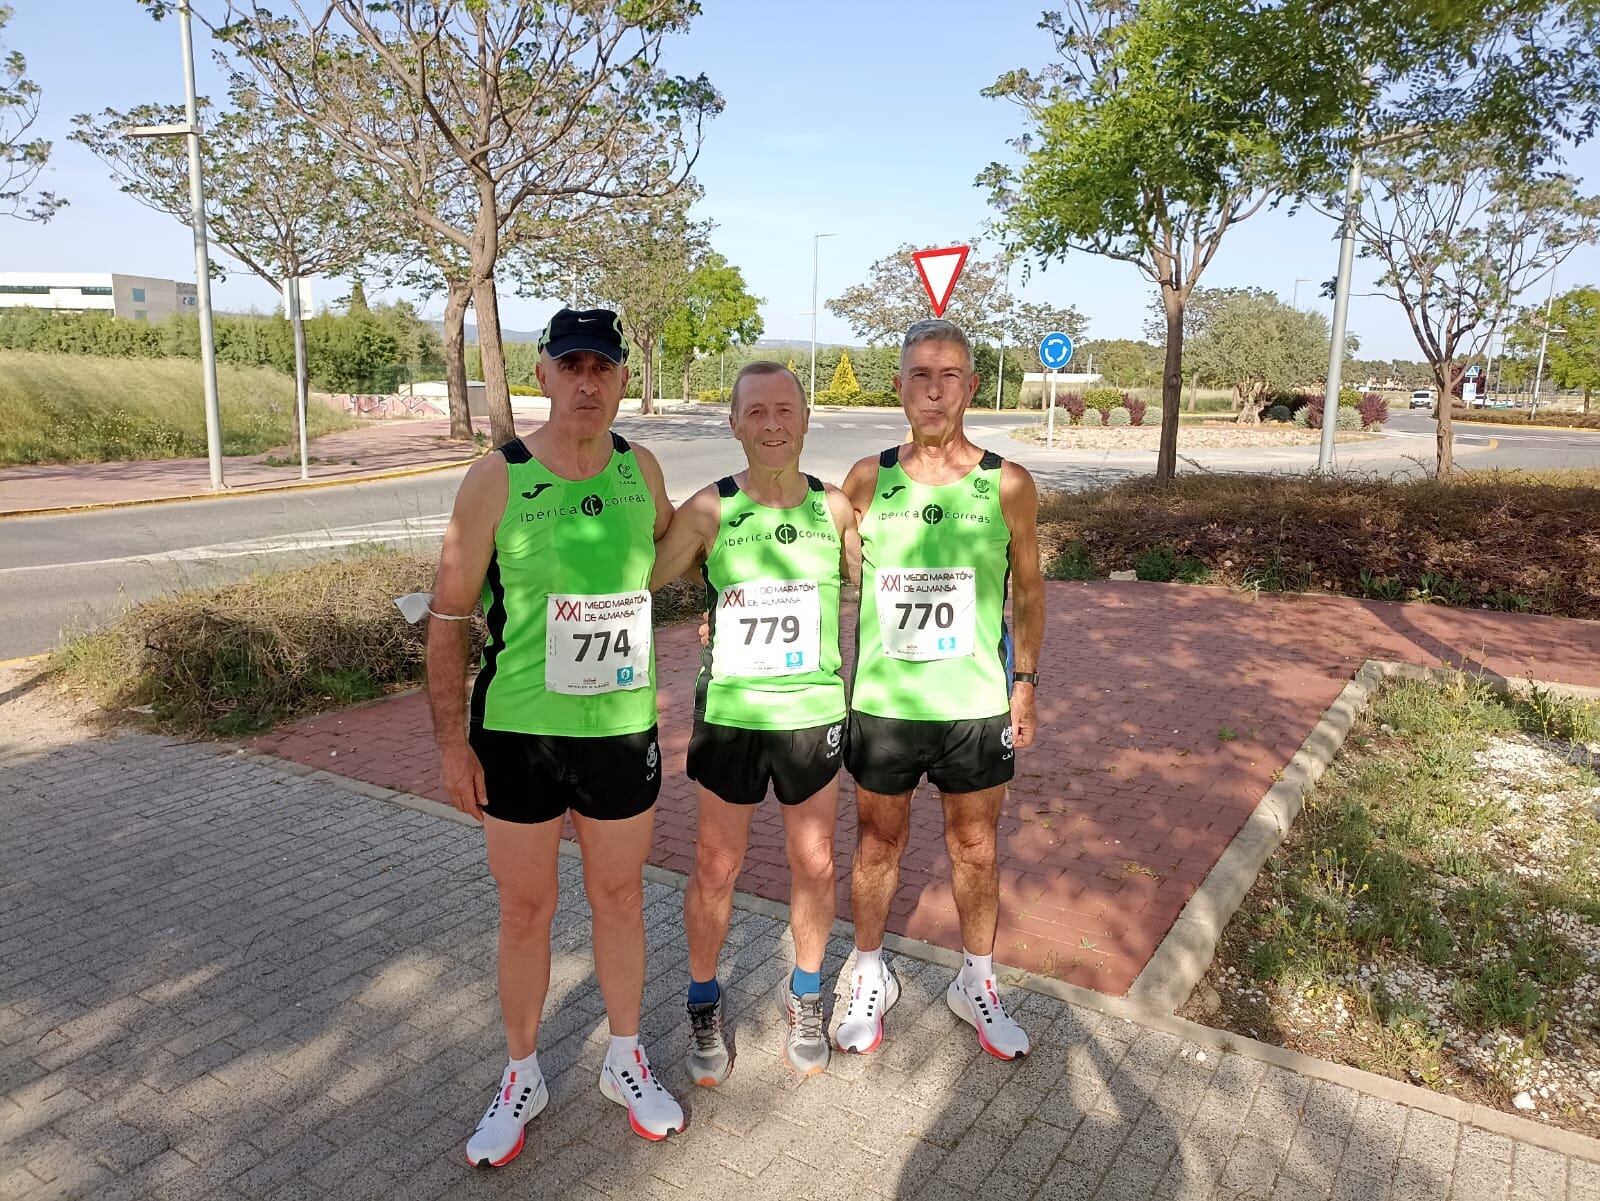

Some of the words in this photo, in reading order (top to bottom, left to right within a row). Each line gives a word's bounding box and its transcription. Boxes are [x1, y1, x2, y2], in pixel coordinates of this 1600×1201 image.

[604, 494, 646, 507] correas
[944, 511, 990, 524] correas
[881, 574, 901, 593] XXI
[903, 585, 915, 593] DE
[915, 584, 957, 593] ALMANSA
[722, 588, 746, 609] XXI
[555, 599, 582, 622] XXI
[584, 613, 597, 622] DE
[598, 610, 635, 621] ALMANSA
[895, 602, 954, 630] 770
[739, 615, 800, 646] 779
[572, 629, 631, 662] 774
